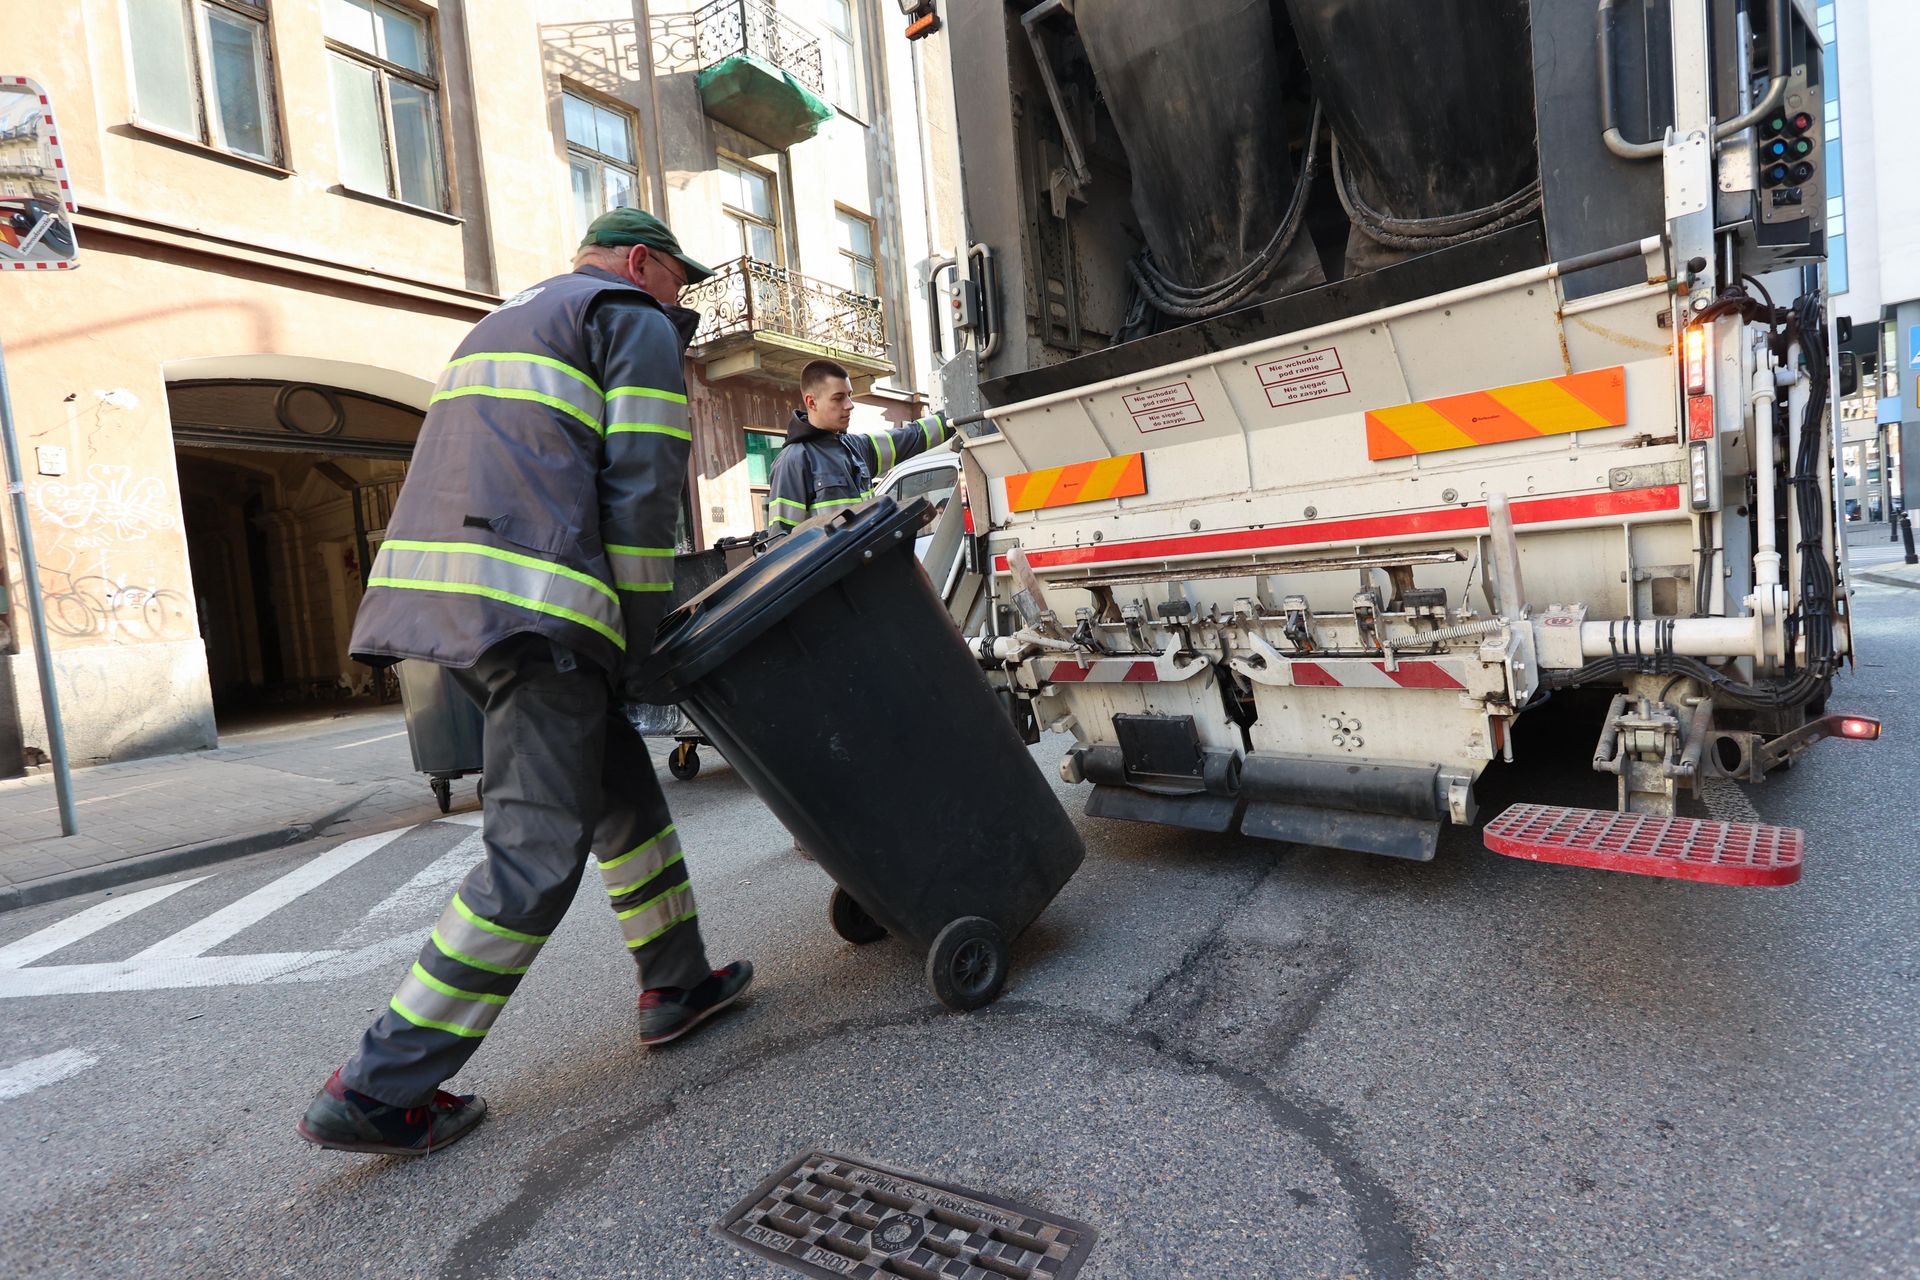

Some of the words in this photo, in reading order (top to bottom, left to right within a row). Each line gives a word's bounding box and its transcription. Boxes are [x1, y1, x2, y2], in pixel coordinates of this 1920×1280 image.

[1285, 355, 1324, 368] wchodzić
[1278, 370, 1294, 378] pod
[1296, 364, 1320, 374] ramię
[1300, 380, 1327, 390] sięgać
[1300, 388, 1328, 397] zasypu
